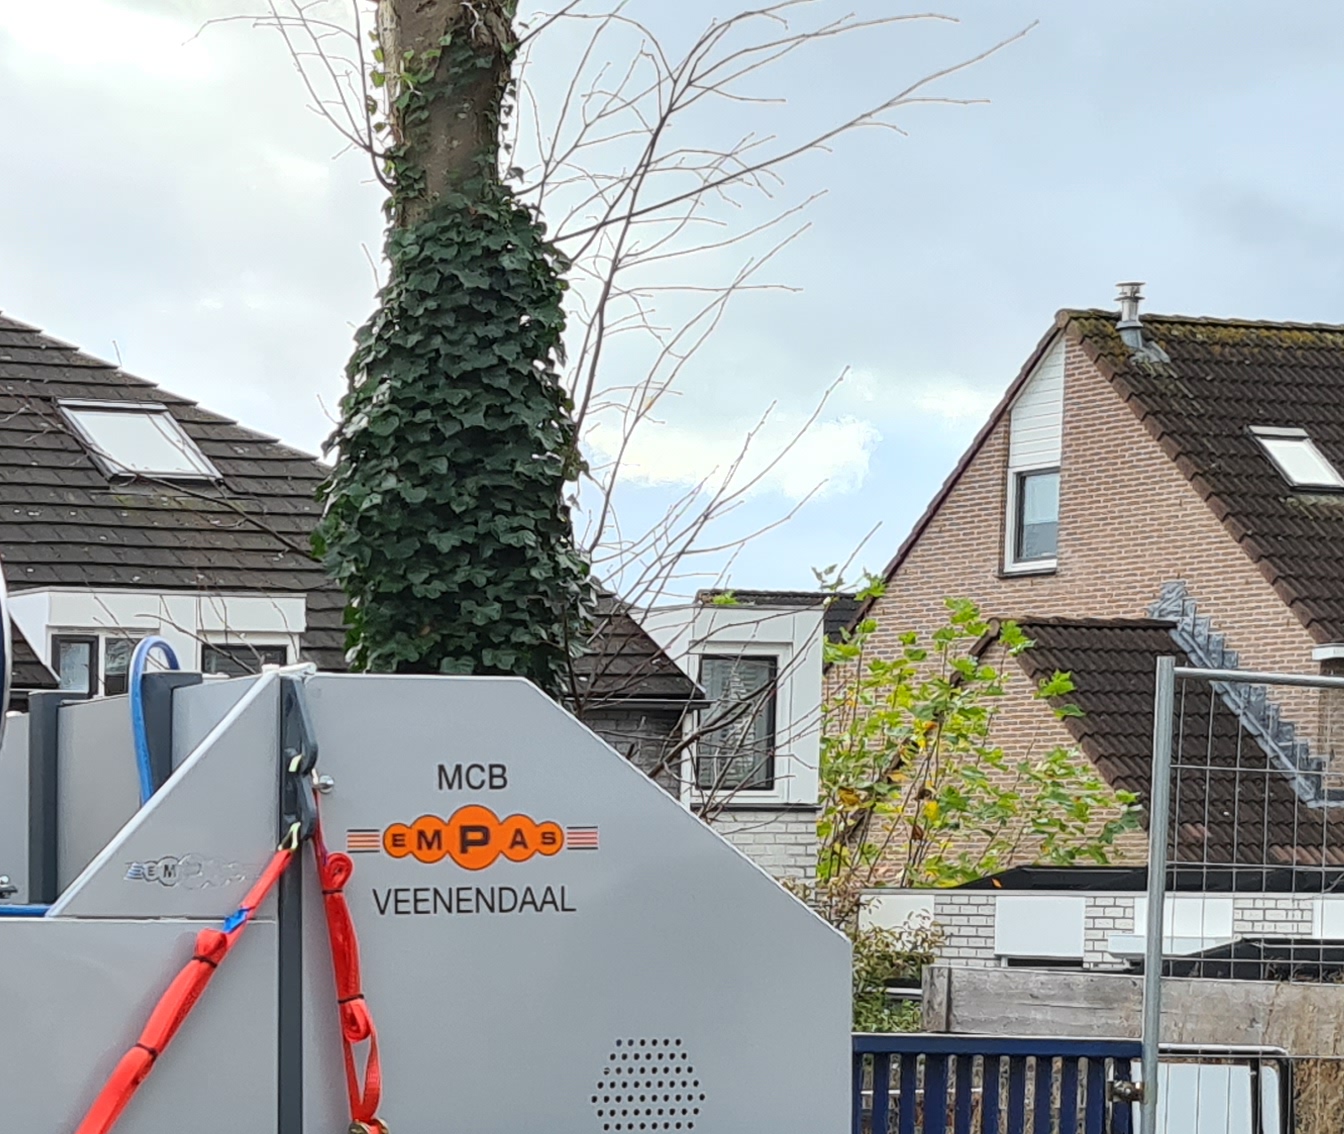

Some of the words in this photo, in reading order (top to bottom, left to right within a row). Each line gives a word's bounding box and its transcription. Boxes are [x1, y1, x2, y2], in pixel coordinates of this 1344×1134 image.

[437, 763, 508, 790] MCB
[391, 825, 557, 855] EMPAS
[372, 885, 576, 915] VEENENDAAL
